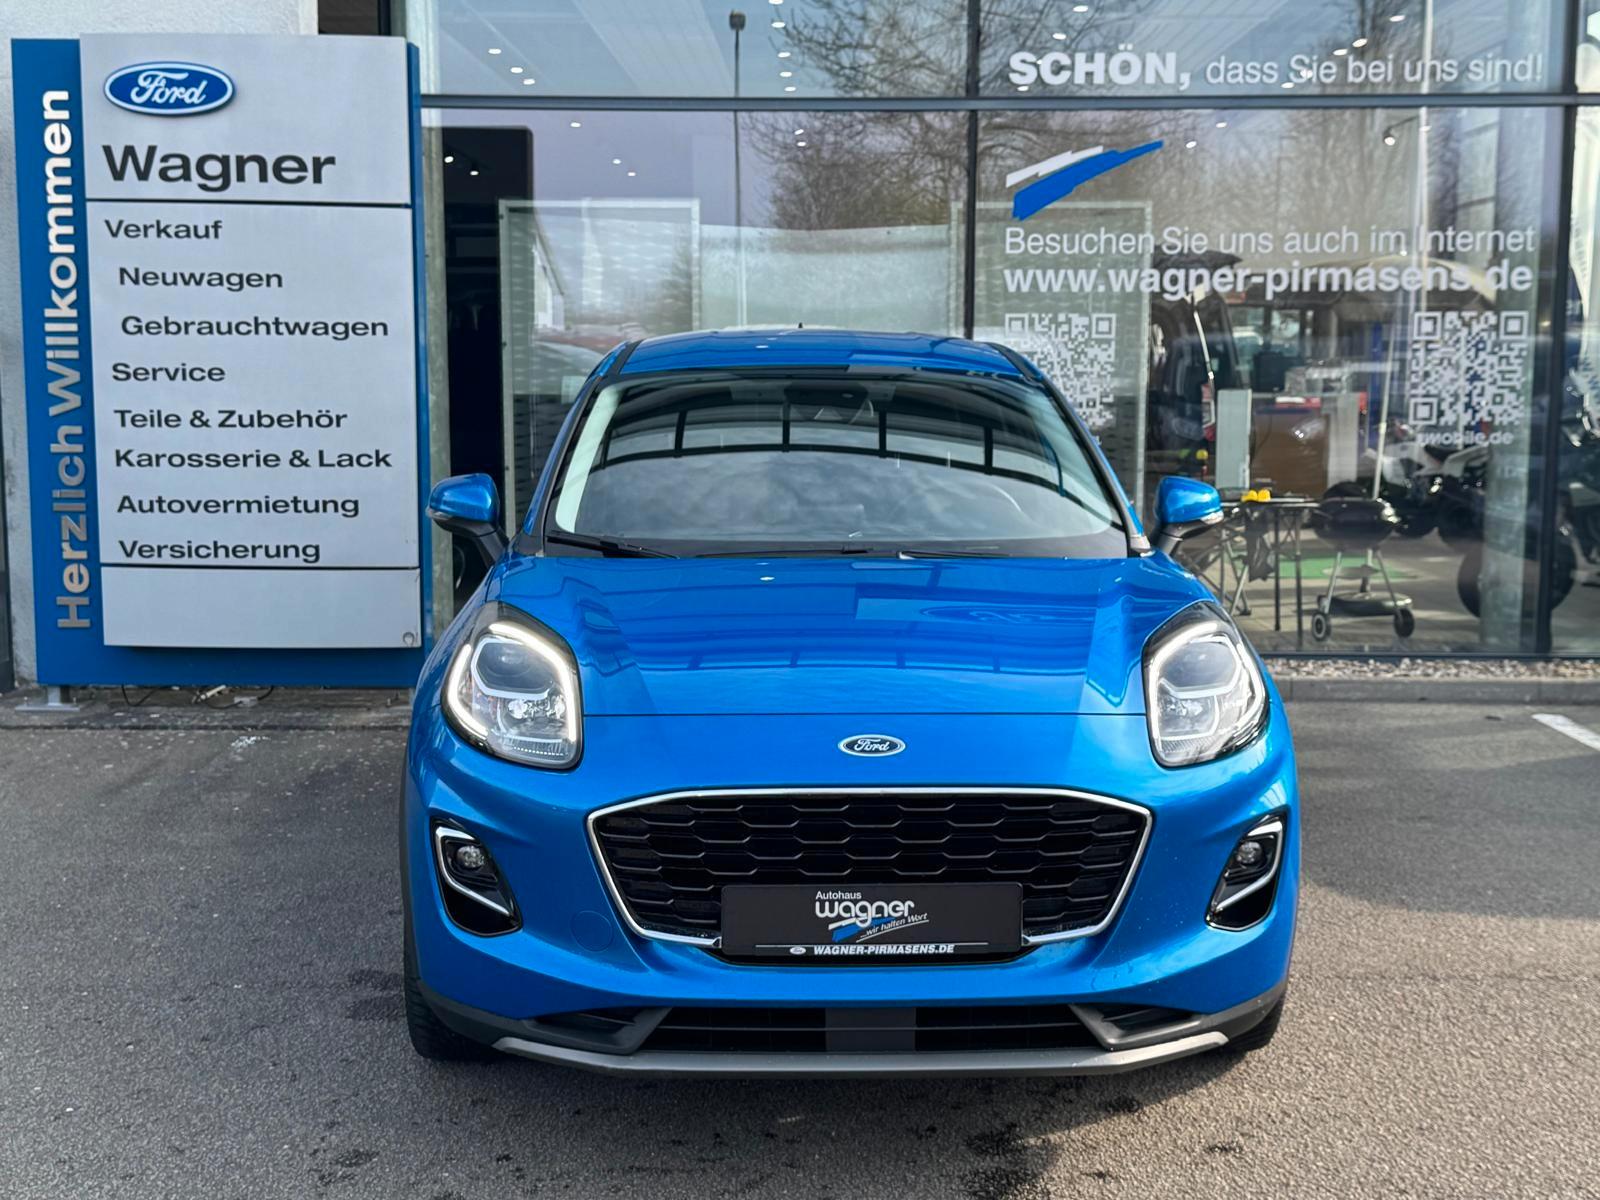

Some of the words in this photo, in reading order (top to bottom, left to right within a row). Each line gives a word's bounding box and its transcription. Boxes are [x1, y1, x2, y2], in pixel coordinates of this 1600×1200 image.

[1008, 43, 1191, 91] SCHÖN,
[1206, 55, 1279, 84] dass
[1289, 54, 1338, 84] Sie
[1348, 54, 1393, 83] bei
[1404, 59, 1458, 83] uns
[1468, 53, 1542, 83] sind!
[130, 70, 206, 104] Ford
[102, 144, 336, 192] Wagner
[104, 219, 222, 239] Verkauf
[1005, 227, 1154, 255] Besuchen
[1162, 226, 1208, 254] Sie
[1219, 233, 1274, 254] uns
[1284, 226, 1359, 253] auch
[1371, 225, 1406, 252] im
[1419, 226, 1536, 252] Internet
[42, 90, 81, 415] Willkommen
[119, 267, 283, 292] Neuwagen
[1004, 259, 1533, 300] www.wagner-pirmasens.de
[121, 315, 389, 341] Gebrauchtwagen
[112, 362, 226, 382] Service
[114, 409, 182, 428] Teile
[189, 410, 211, 428] &
[217, 408, 348, 428] Zubehör
[114, 449, 281, 468] Karosserie
[288, 450, 311, 468] &
[318, 449, 392, 469] Lack
[117, 495, 360, 518] Autovermietung
[51, 425, 91, 628] Herzlich
[118, 540, 321, 564] Versicherung
[815, 891, 862, 900] Autohaus
[815, 900, 915, 928] wagner
[881, 918, 906, 932] halten
[908, 912, 928, 924] Wort
[814, 944, 954, 956] WAGNER-PIRMASENS.DE
